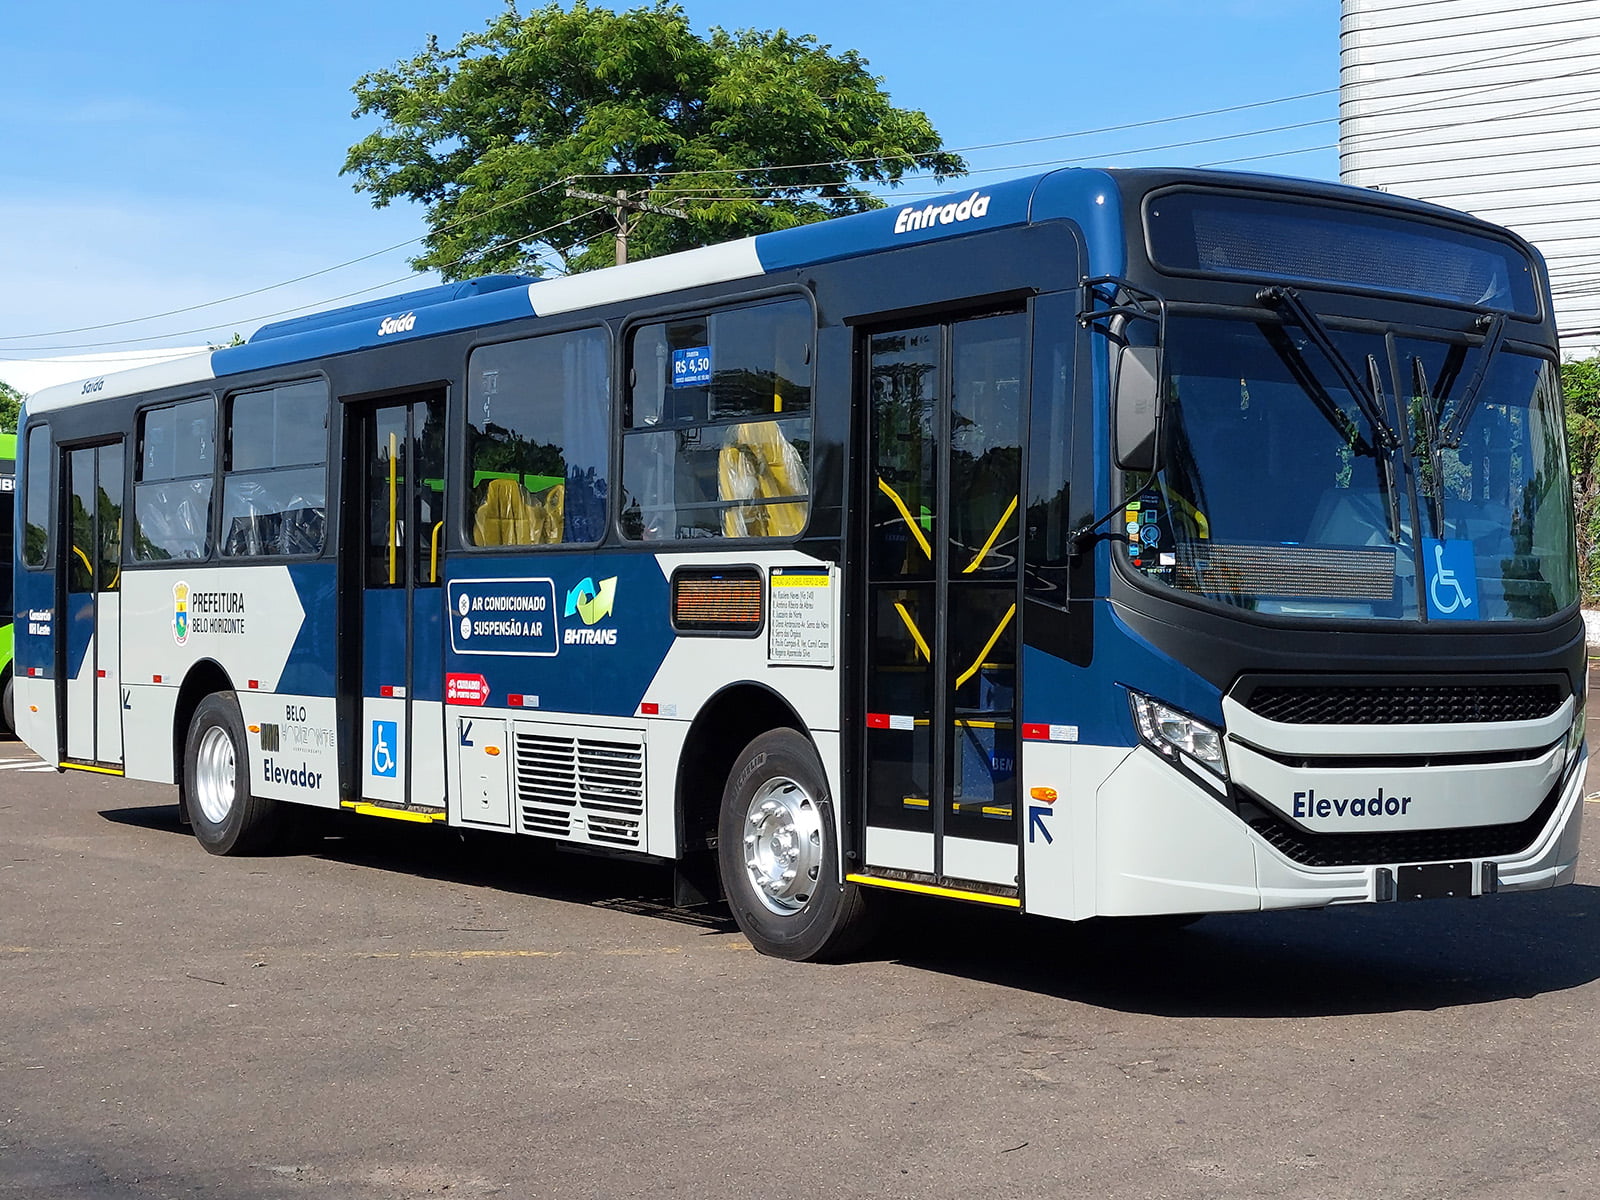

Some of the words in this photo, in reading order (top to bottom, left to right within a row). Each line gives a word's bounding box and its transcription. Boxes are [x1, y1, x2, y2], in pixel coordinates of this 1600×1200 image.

[894, 191, 991, 234] Entrada
[377, 311, 417, 337] Saída
[675, 360, 687, 374] R$
[689, 357, 709, 374] 4,50
[81, 376, 105, 395] Saída
[192, 593, 245, 613] PREFEITURA
[471, 597, 483, 611] AR
[484, 596, 546, 611] CONDICIONADO
[192, 618, 208, 633] BELO
[209, 618, 245, 634] HORIZONTE
[473, 618, 522, 636] SUSPENSÃO
[522, 622, 529, 636] A
[530, 622, 543, 637] AR
[563, 629, 617, 645] BHTRANS
[286, 705, 307, 722] BELO
[263, 757, 323, 789] Elevador
[1293, 788, 1412, 818] Elevador
